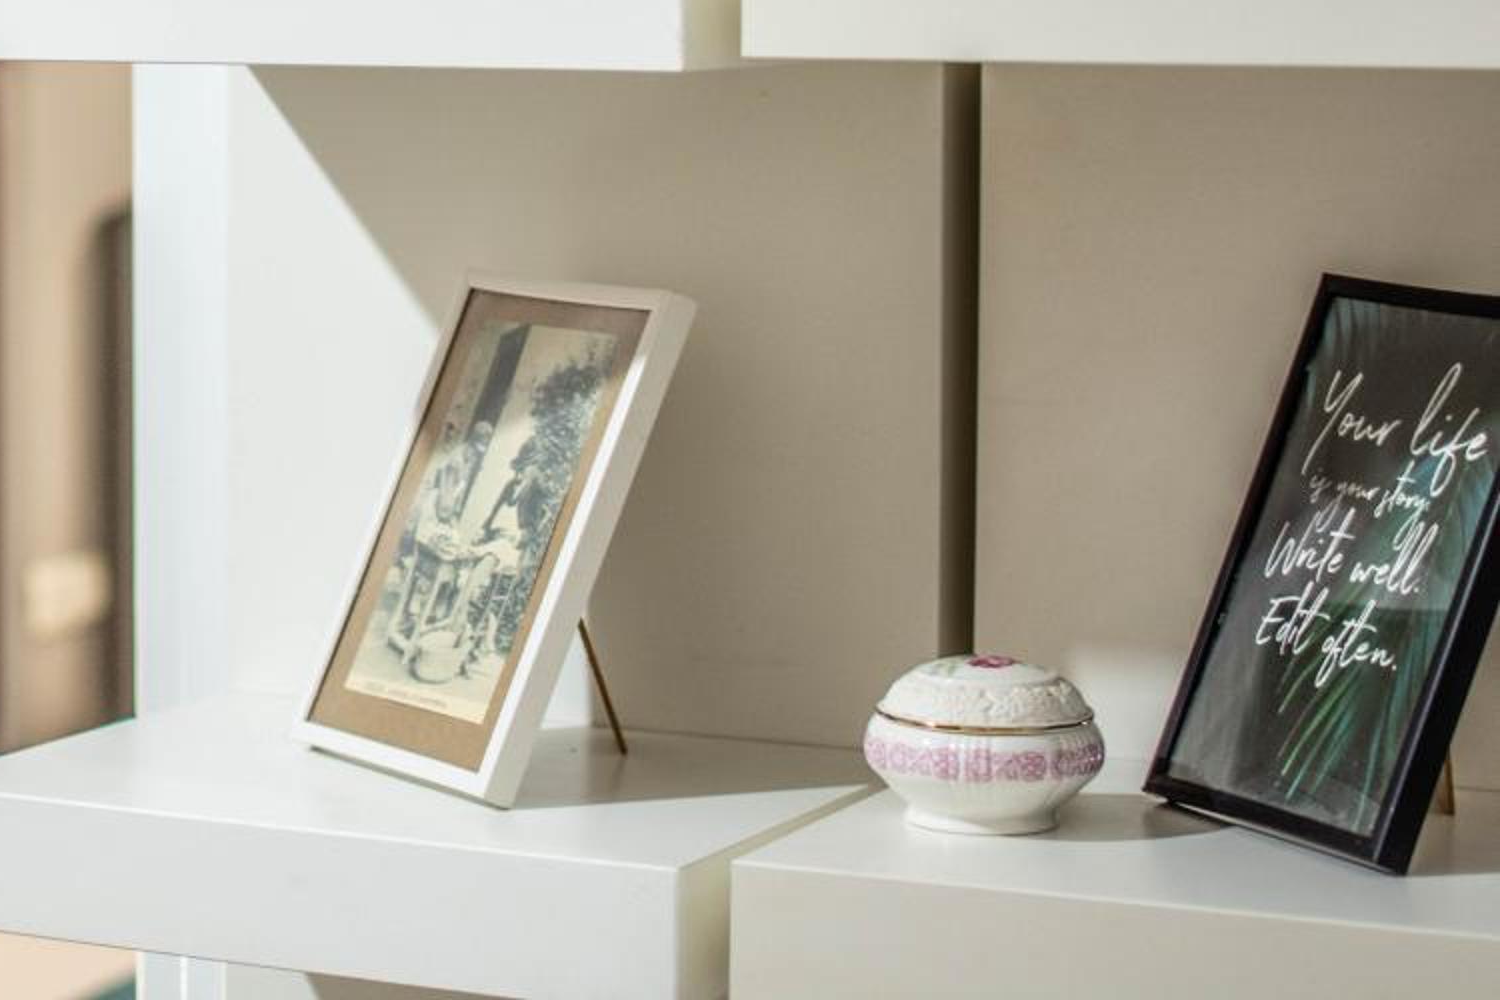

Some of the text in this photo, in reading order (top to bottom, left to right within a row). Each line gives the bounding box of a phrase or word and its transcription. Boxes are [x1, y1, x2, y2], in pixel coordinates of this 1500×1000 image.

[1301, 362, 1489, 498] Your life
[1263, 507, 1440, 596] Write well.
[1315, 480, 1381, 533] your
[1255, 580, 1397, 689] Edit often.
